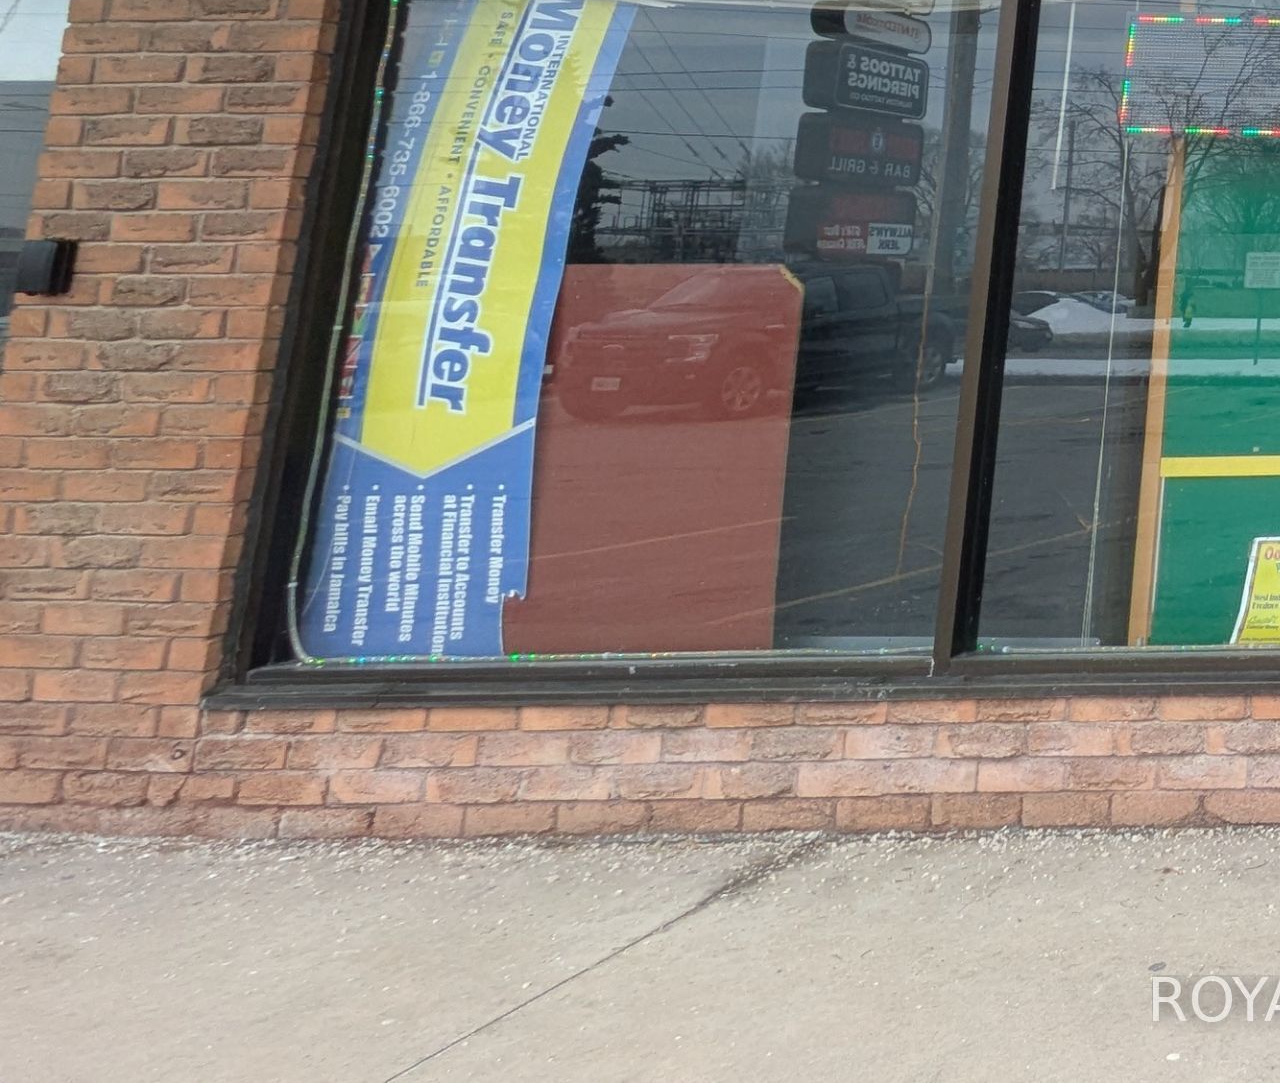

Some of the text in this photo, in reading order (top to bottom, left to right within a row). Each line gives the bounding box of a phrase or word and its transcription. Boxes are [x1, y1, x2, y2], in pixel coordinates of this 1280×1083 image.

[369, 69, 440, 238] 1-866-735-6002
[415, 11, 514, 289] SAFE CONVENIENT AFFORDABLE
[516, 34, 572, 161] INTERNATIONAL
[428, 174, 525, 415] Transfer
[323, 573, 344, 632] Jamaica
[333, 522, 348, 553] bills
[351, 495, 380, 646] Email Money Transfer
[385, 495, 407, 612] across the world
[398, 495, 425, 642] Send Mobile Minutes
[431, 495, 457, 656] at Financial Institution
[451, 495, 476, 641] Transfer to Accounts
[485, 495, 507, 604] Transfer Money
